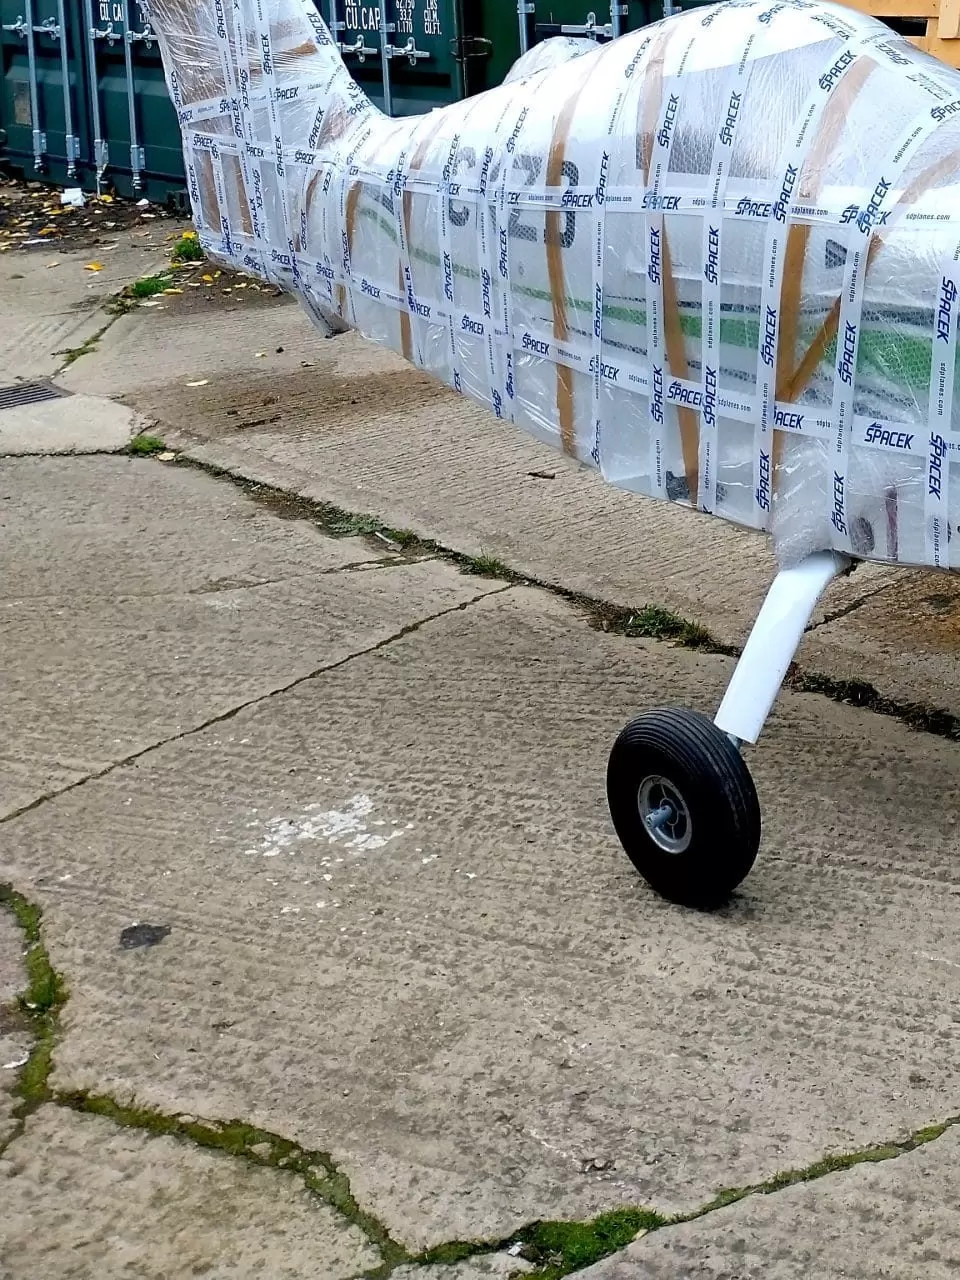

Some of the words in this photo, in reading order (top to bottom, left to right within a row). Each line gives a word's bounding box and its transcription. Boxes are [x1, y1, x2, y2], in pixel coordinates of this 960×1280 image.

[216, 0, 226, 39] SPACEK
[307, 12, 331, 46] SPACEK
[400, 10, 412, 21] 33.2
[261, 34, 273, 75] SPACEK
[625, 37, 652, 79] SPACEK
[818, 49, 857, 93] SPACEK
[309, 107, 325, 149] SPACEK
[507, 106, 529, 154] SPACEK
[657, 94, 680, 149] SPACEK
[718, 91, 742, 147] SPACEK
[275, 135, 284, 177] SPACEK
[442, 133, 461, 182] SPACEK
[893, 126, 923, 164] sdplanes.com
[479, 146, 494, 198] SPACEK
[773, 163, 799, 224] SPACEK
[561, 190, 594, 208] SPACEK
[791, 205, 829, 217] sdplanes.com
[859, 176, 893, 236] SPACEK
[906, 213, 951, 221] sdplanes.com
[500, 226, 508, 280] SPACEK
[648, 227, 661, 285] SPACEK
[704, 225, 719, 285] SPACEK
[849, 252, 859, 303] sdplanes.com
[360, 280, 381, 298] SPACEK
[481, 268, 492, 319] SPACEK
[937, 276, 958, 345] SPACEK
[522, 333, 549, 355] SPACEK
[760, 305, 778, 368] SPACEK
[838, 320, 857, 387] SPACEK
[651, 366, 663, 425] SPACEK
[704, 366, 717, 427] SPACEK
[718, 398, 751, 412] sdplanes.com
[938, 363, 946, 416] sdplanes.com
[837, 401, 846, 453] sdplanes.com
[865, 423, 914, 450] SPACEK
[755, 449, 770, 513] SPACEK
[929, 432, 948, 501] SPACEK
[831, 471, 847, 536] SPACEK
